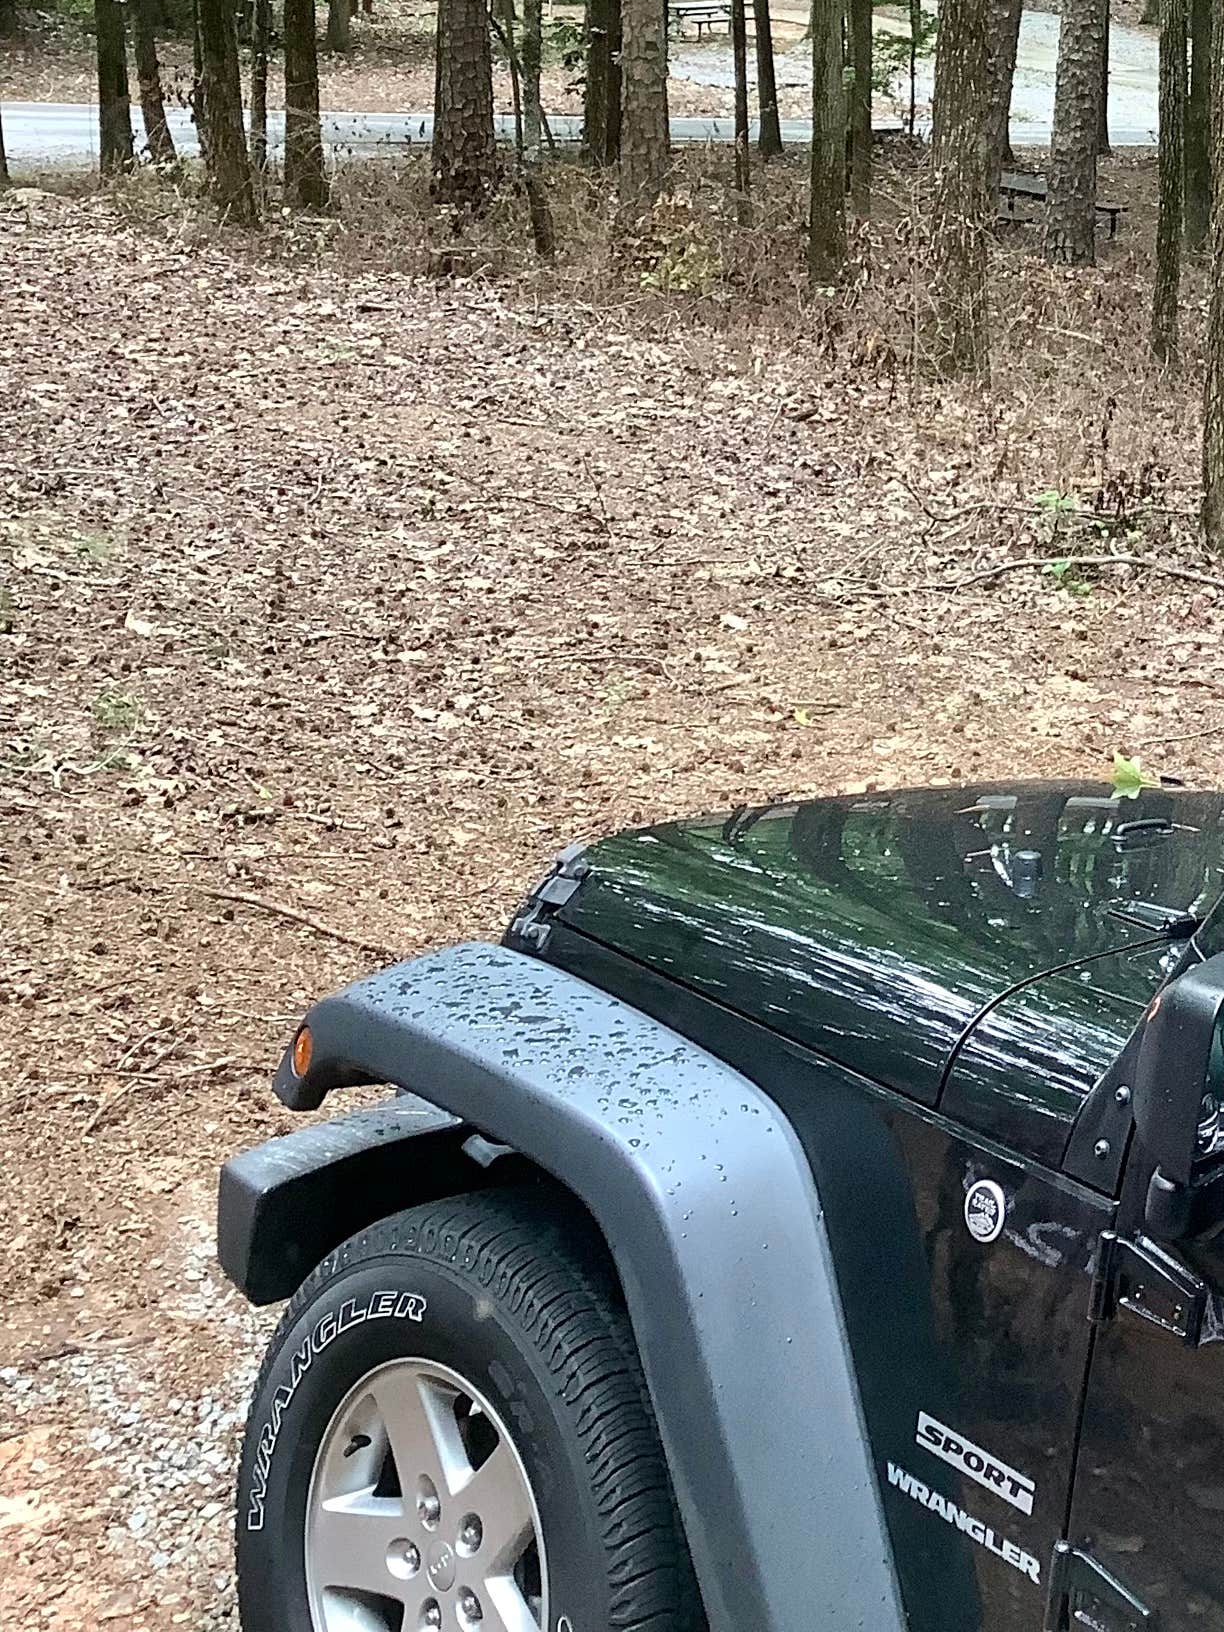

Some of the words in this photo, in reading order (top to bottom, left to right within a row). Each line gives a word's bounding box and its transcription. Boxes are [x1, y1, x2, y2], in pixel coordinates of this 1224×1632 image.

[247, 1290, 428, 1531] WRANGLER
[915, 1423, 1036, 1499] SPORT
[887, 1460, 1042, 1585] WRANGLER
